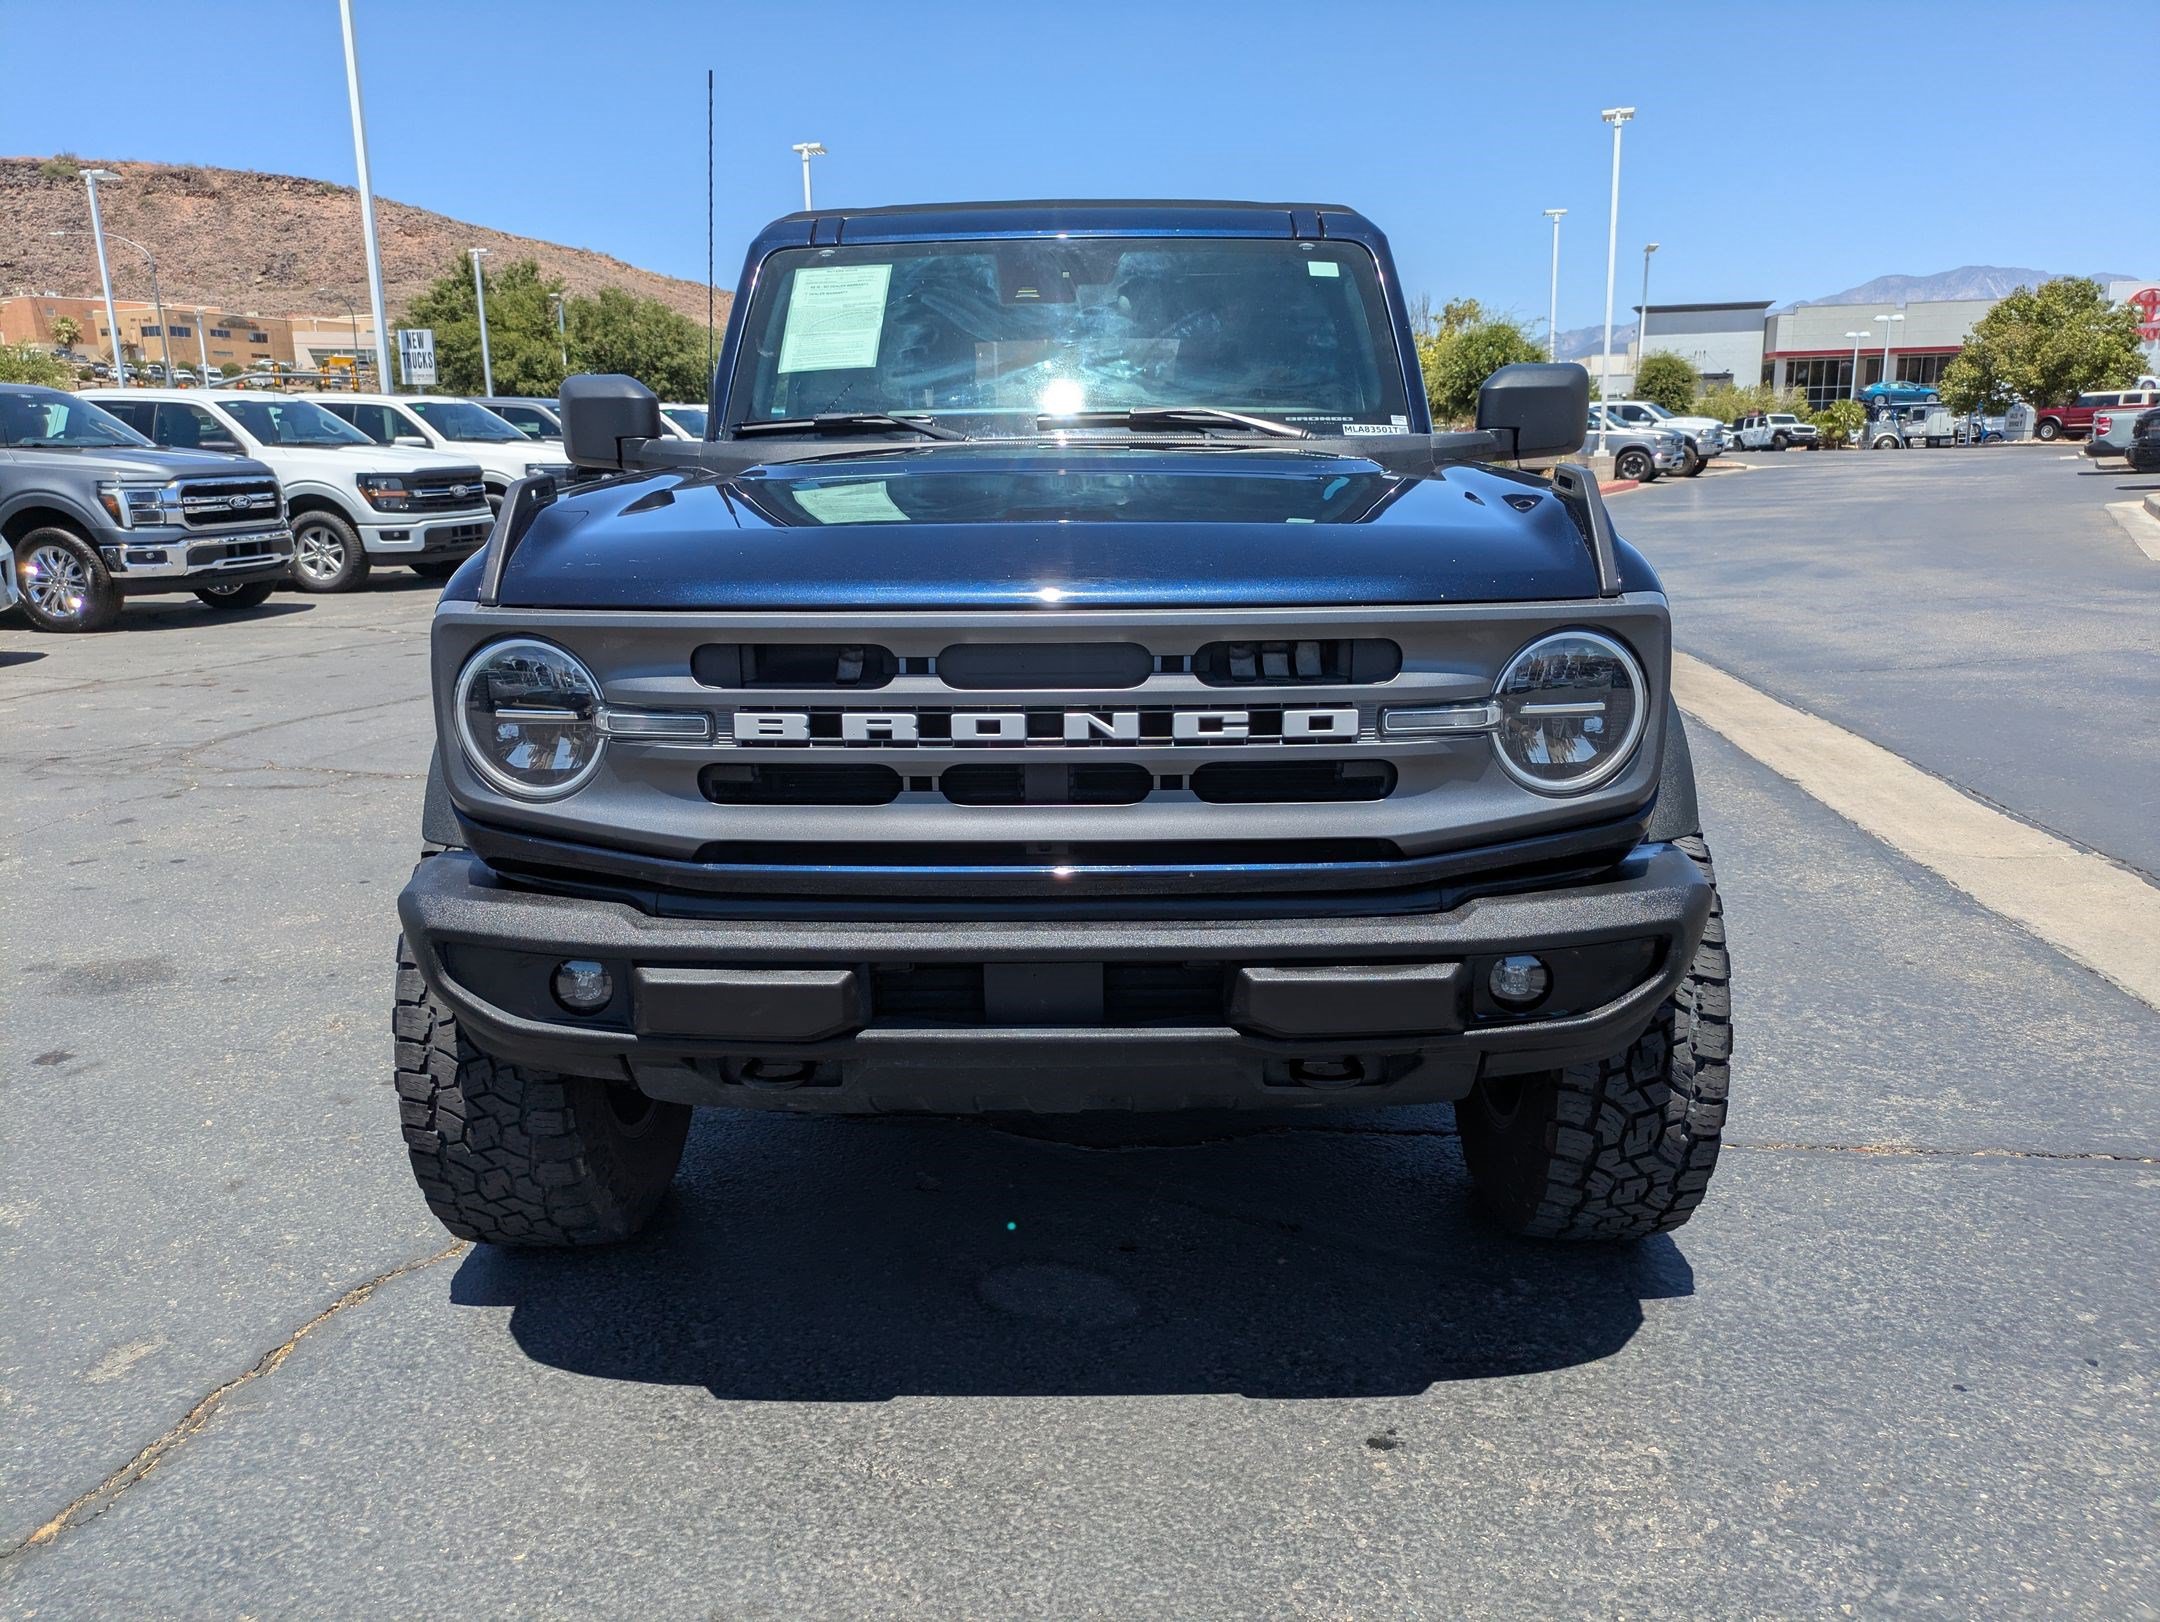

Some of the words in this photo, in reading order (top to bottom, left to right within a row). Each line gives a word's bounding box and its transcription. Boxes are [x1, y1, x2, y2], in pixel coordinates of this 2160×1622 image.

[405, 331, 424, 349] NEW
[402, 352, 433, 369] TRUCKS
[1344, 425, 1399, 434] MLA83501T
[733, 709, 1360, 742] BRONCO
